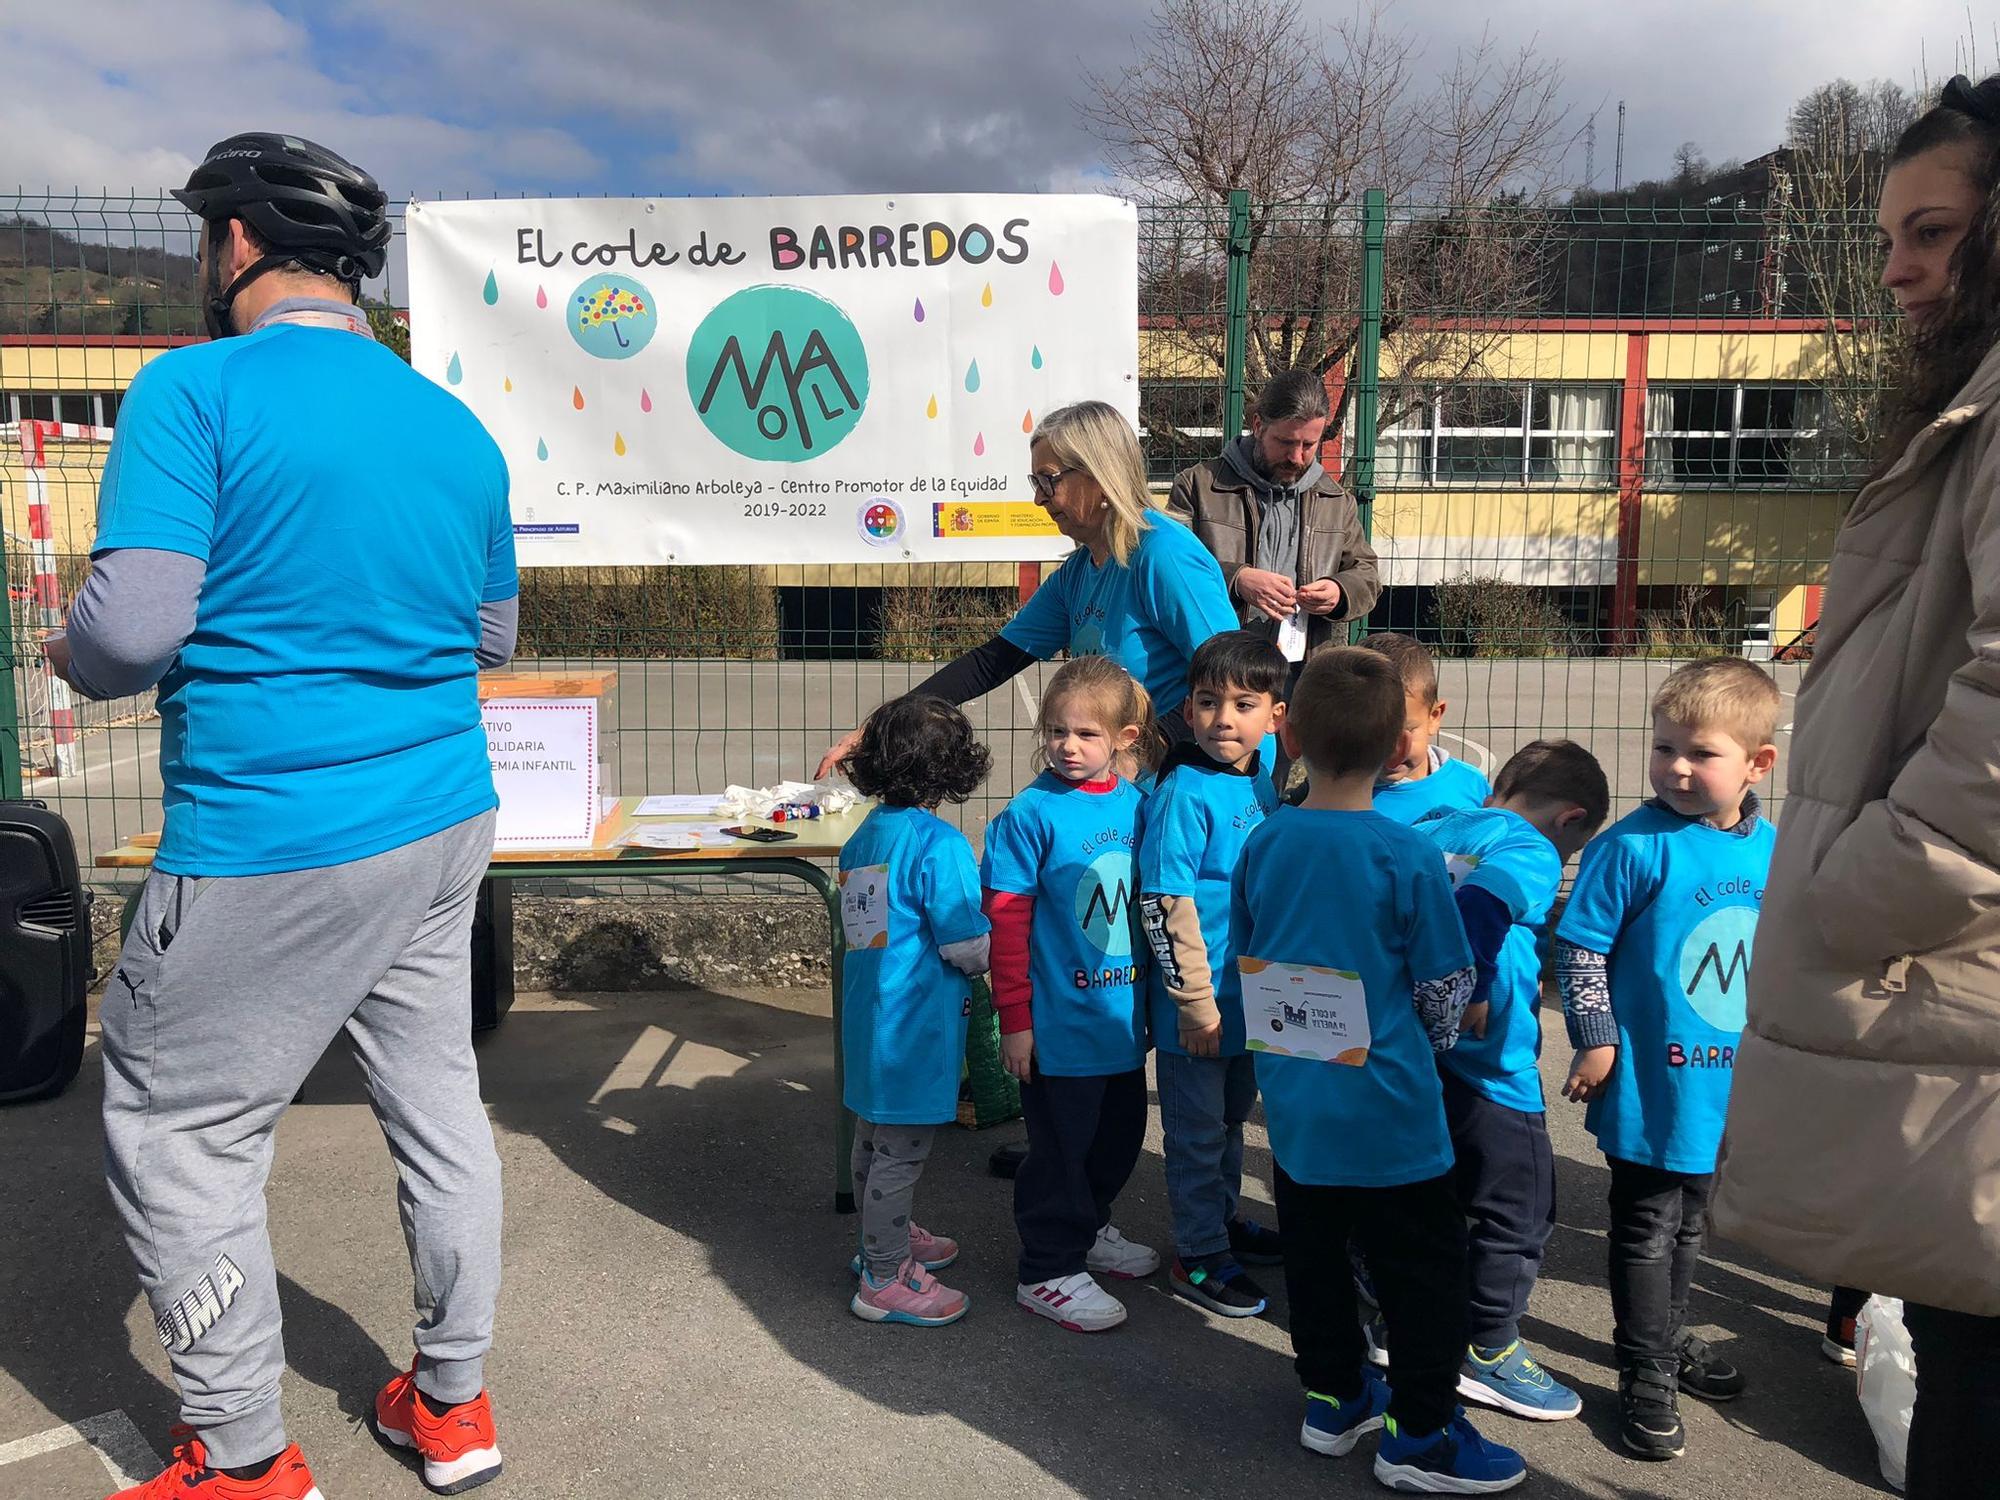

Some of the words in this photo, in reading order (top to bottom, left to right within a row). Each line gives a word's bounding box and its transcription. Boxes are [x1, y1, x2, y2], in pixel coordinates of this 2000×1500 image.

[216, 149, 262, 160] GIRO
[517, 228, 563, 268] El
[571, 228, 681, 268] cole
[687, 230, 747, 268] de
[769, 218, 1030, 271] BARREDOS
[557, 481, 571, 497] C.
[576, 481, 590, 497] P.
[595, 479, 691, 497] Maximiliano
[695, 479, 763, 499] Arboleya
[780, 479, 830, 494] Centro
[835, 478, 905, 493] Promotor
[910, 476, 928, 493] de
[932, 476, 946, 492] la
[950, 475, 1008, 498] Equidad
[744, 502, 827, 518] 2019-2022
[488, 741, 546, 752] OLIDARIA
[490, 760, 520, 771] EMIA
[522, 760, 577, 772] INFANTIL
[1082, 839, 1095, 855] El
[1095, 826, 1119, 845] cole
[1121, 831, 1136, 849] de
[1694, 887, 1714, 907] El
[1717, 876, 1751, 896] cole
[1141, 898, 1186, 989] MINECR
[1667, 1042, 1735, 1068] BARR
